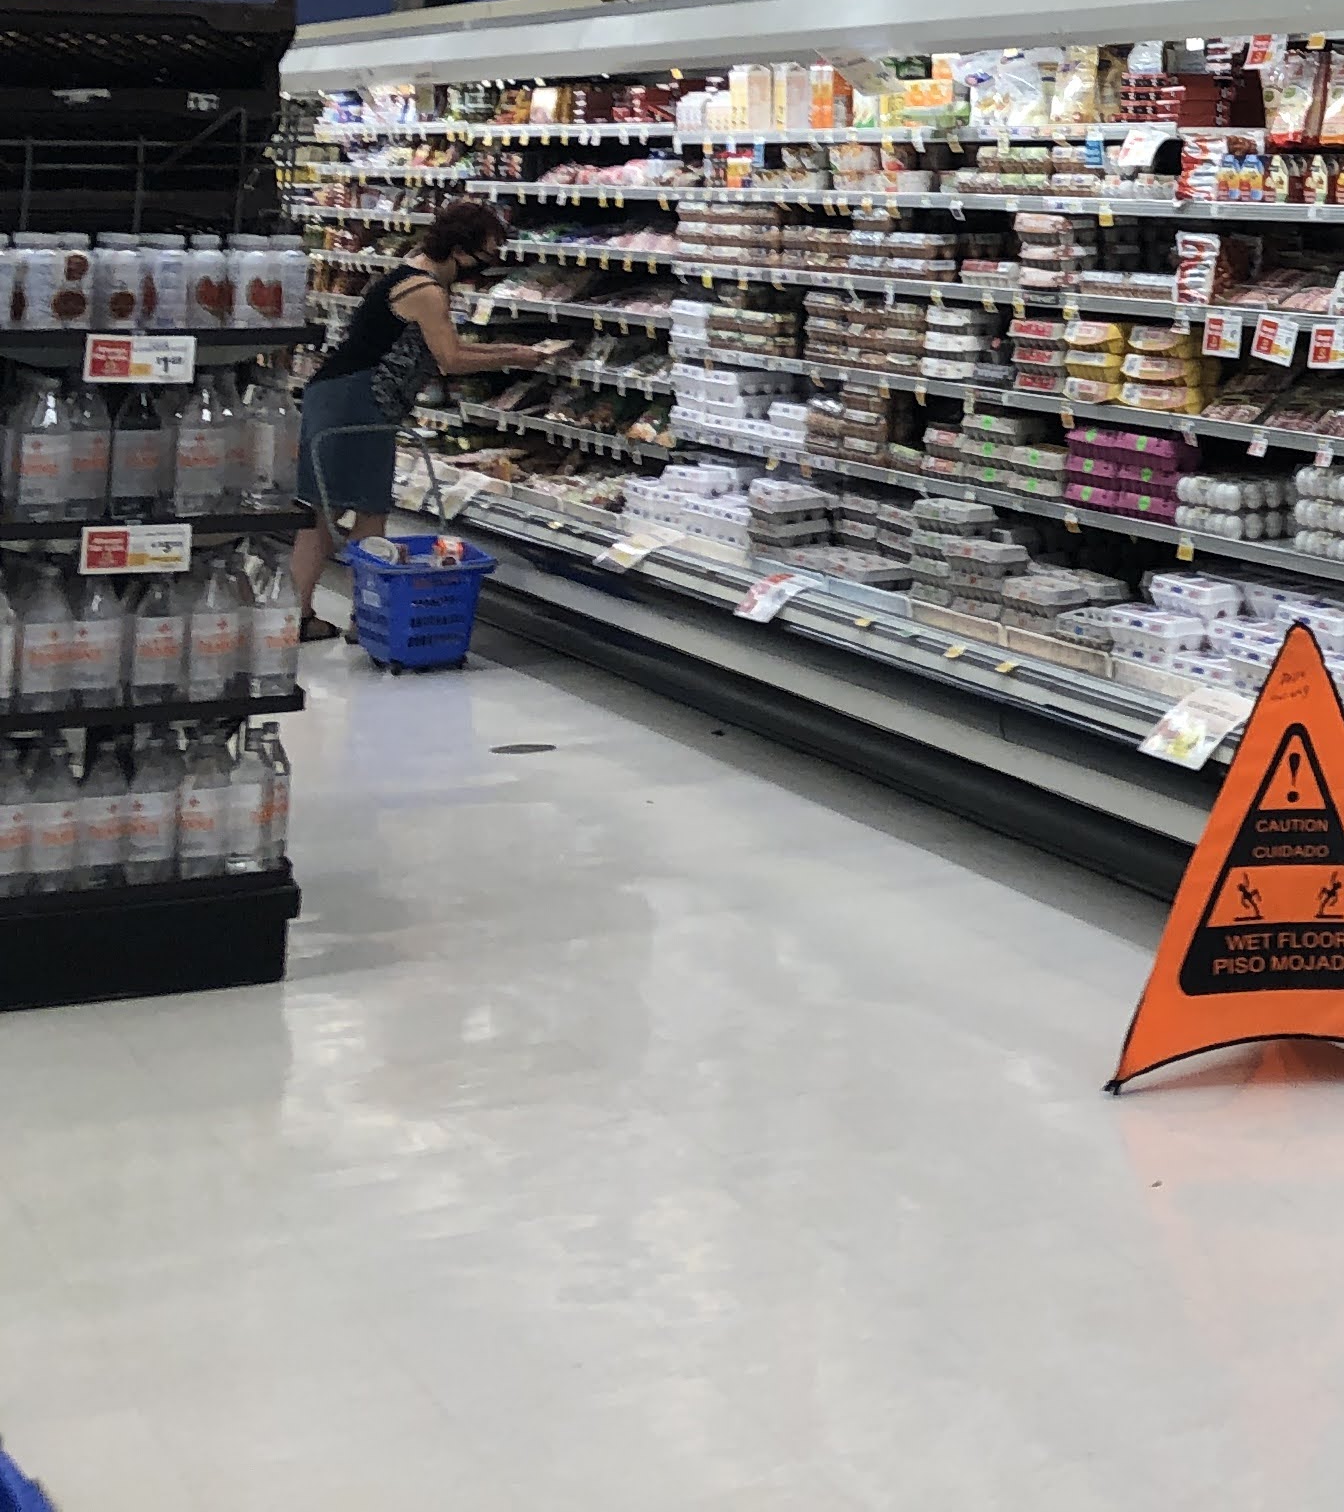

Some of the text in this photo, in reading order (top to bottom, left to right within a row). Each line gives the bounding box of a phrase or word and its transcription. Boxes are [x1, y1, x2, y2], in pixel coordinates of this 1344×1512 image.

[1255, 818, 1328, 833] CAUTION
[1252, 844, 1329, 859] CUIDADO
[1225, 934, 1272, 952] WET
[1212, 958, 1264, 975] PISO
